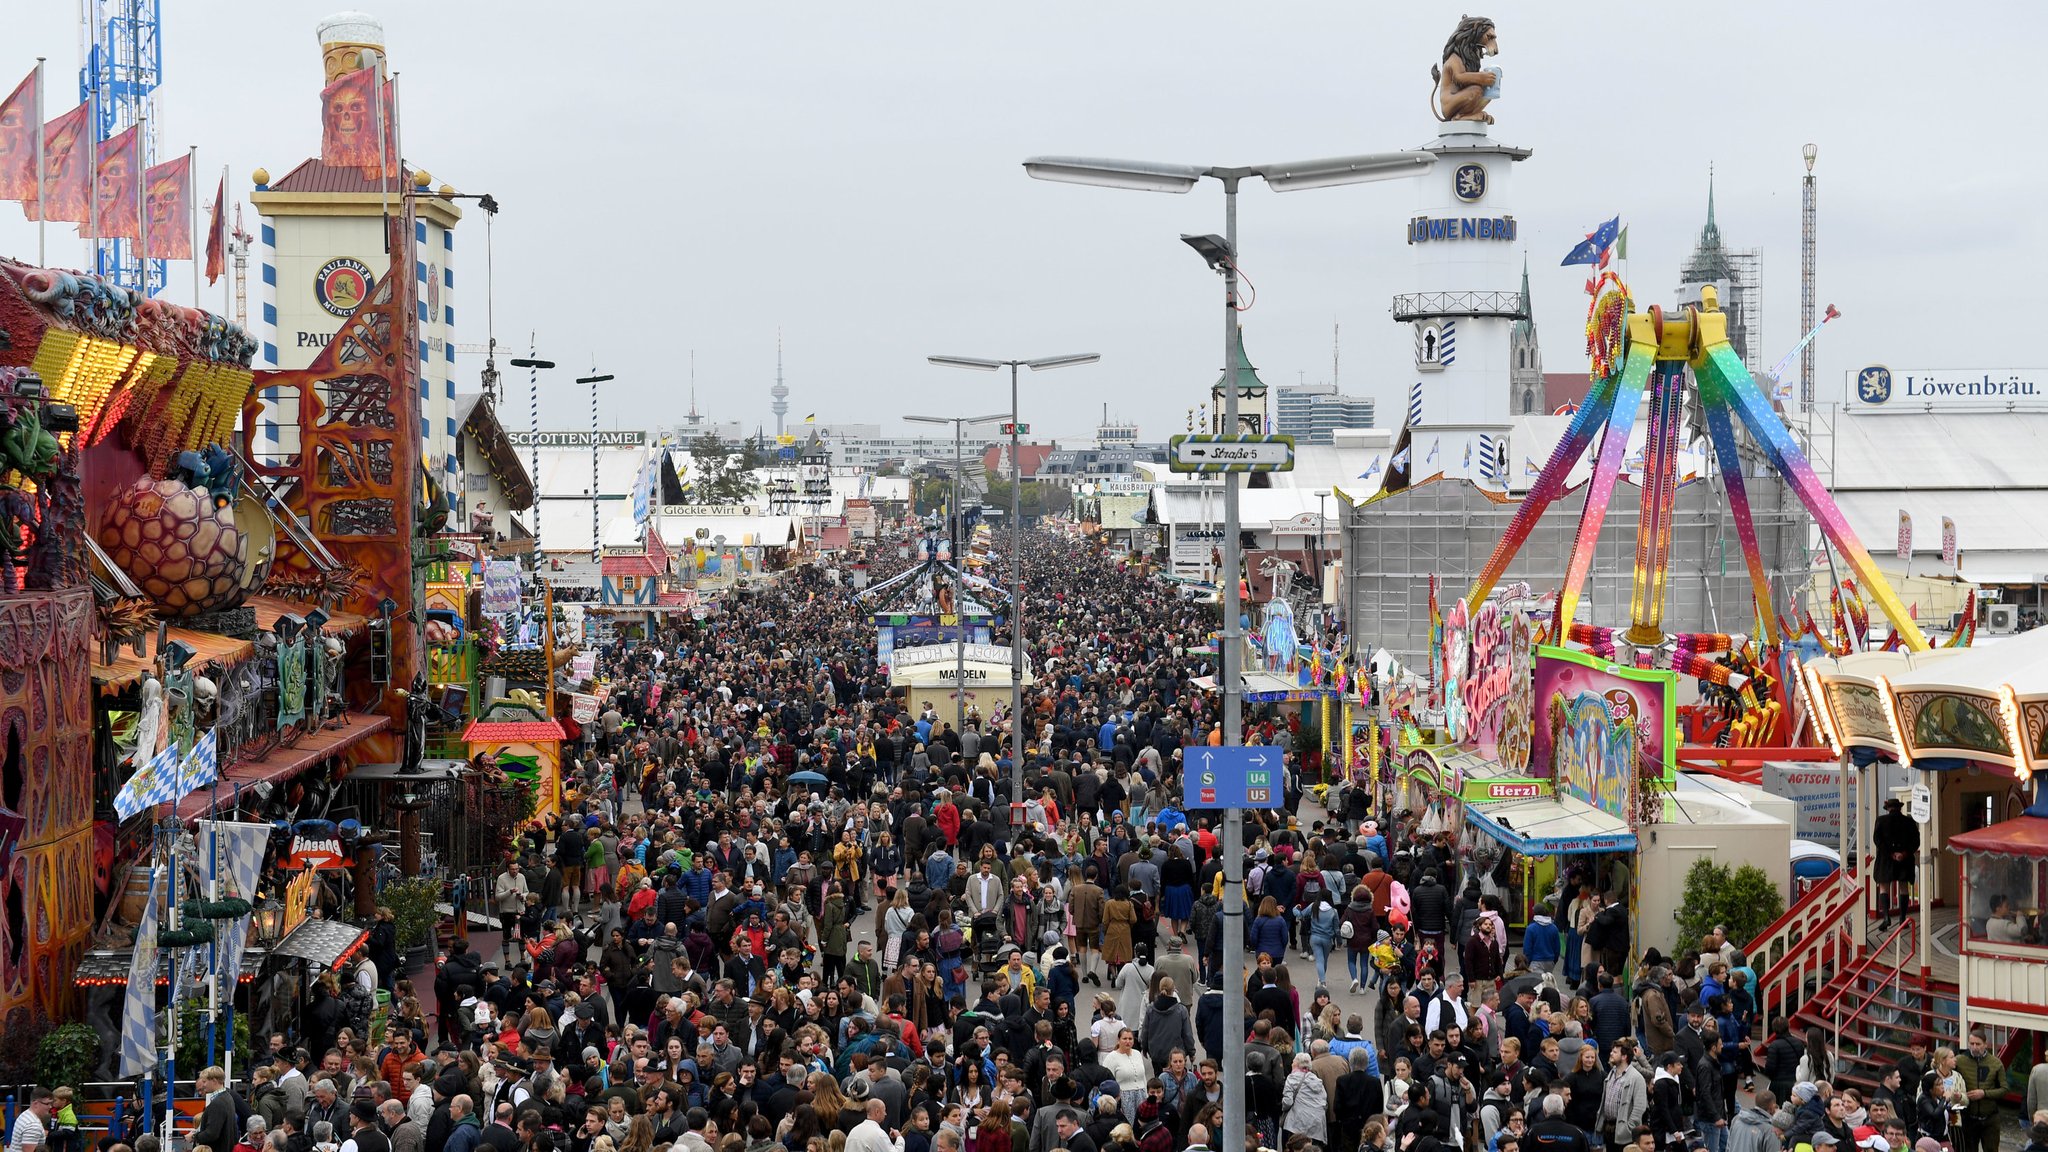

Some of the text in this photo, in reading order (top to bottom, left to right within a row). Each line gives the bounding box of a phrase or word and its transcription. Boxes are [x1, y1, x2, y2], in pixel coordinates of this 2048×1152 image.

[317, 259, 371, 281] PAULANER
[1907, 375, 2041, 396] Löwenbräu.
[1210, 448, 1258, 460] Straße 5
[664, 506, 735, 515] Glöckle Wirt
[939, 670, 986, 680] MADELN
[1202, 772, 1213, 785] S
[1250, 773, 1266, 784] U4
[1788, 774, 1830, 784] AGTSCH
[1250, 790, 1266, 800] U5
[1493, 786, 1537, 796] Herzl
[291, 835, 343, 857] Eingang
[1543, 840, 1560, 850] Auf
[1592, 838, 1620, 848] Buam!
